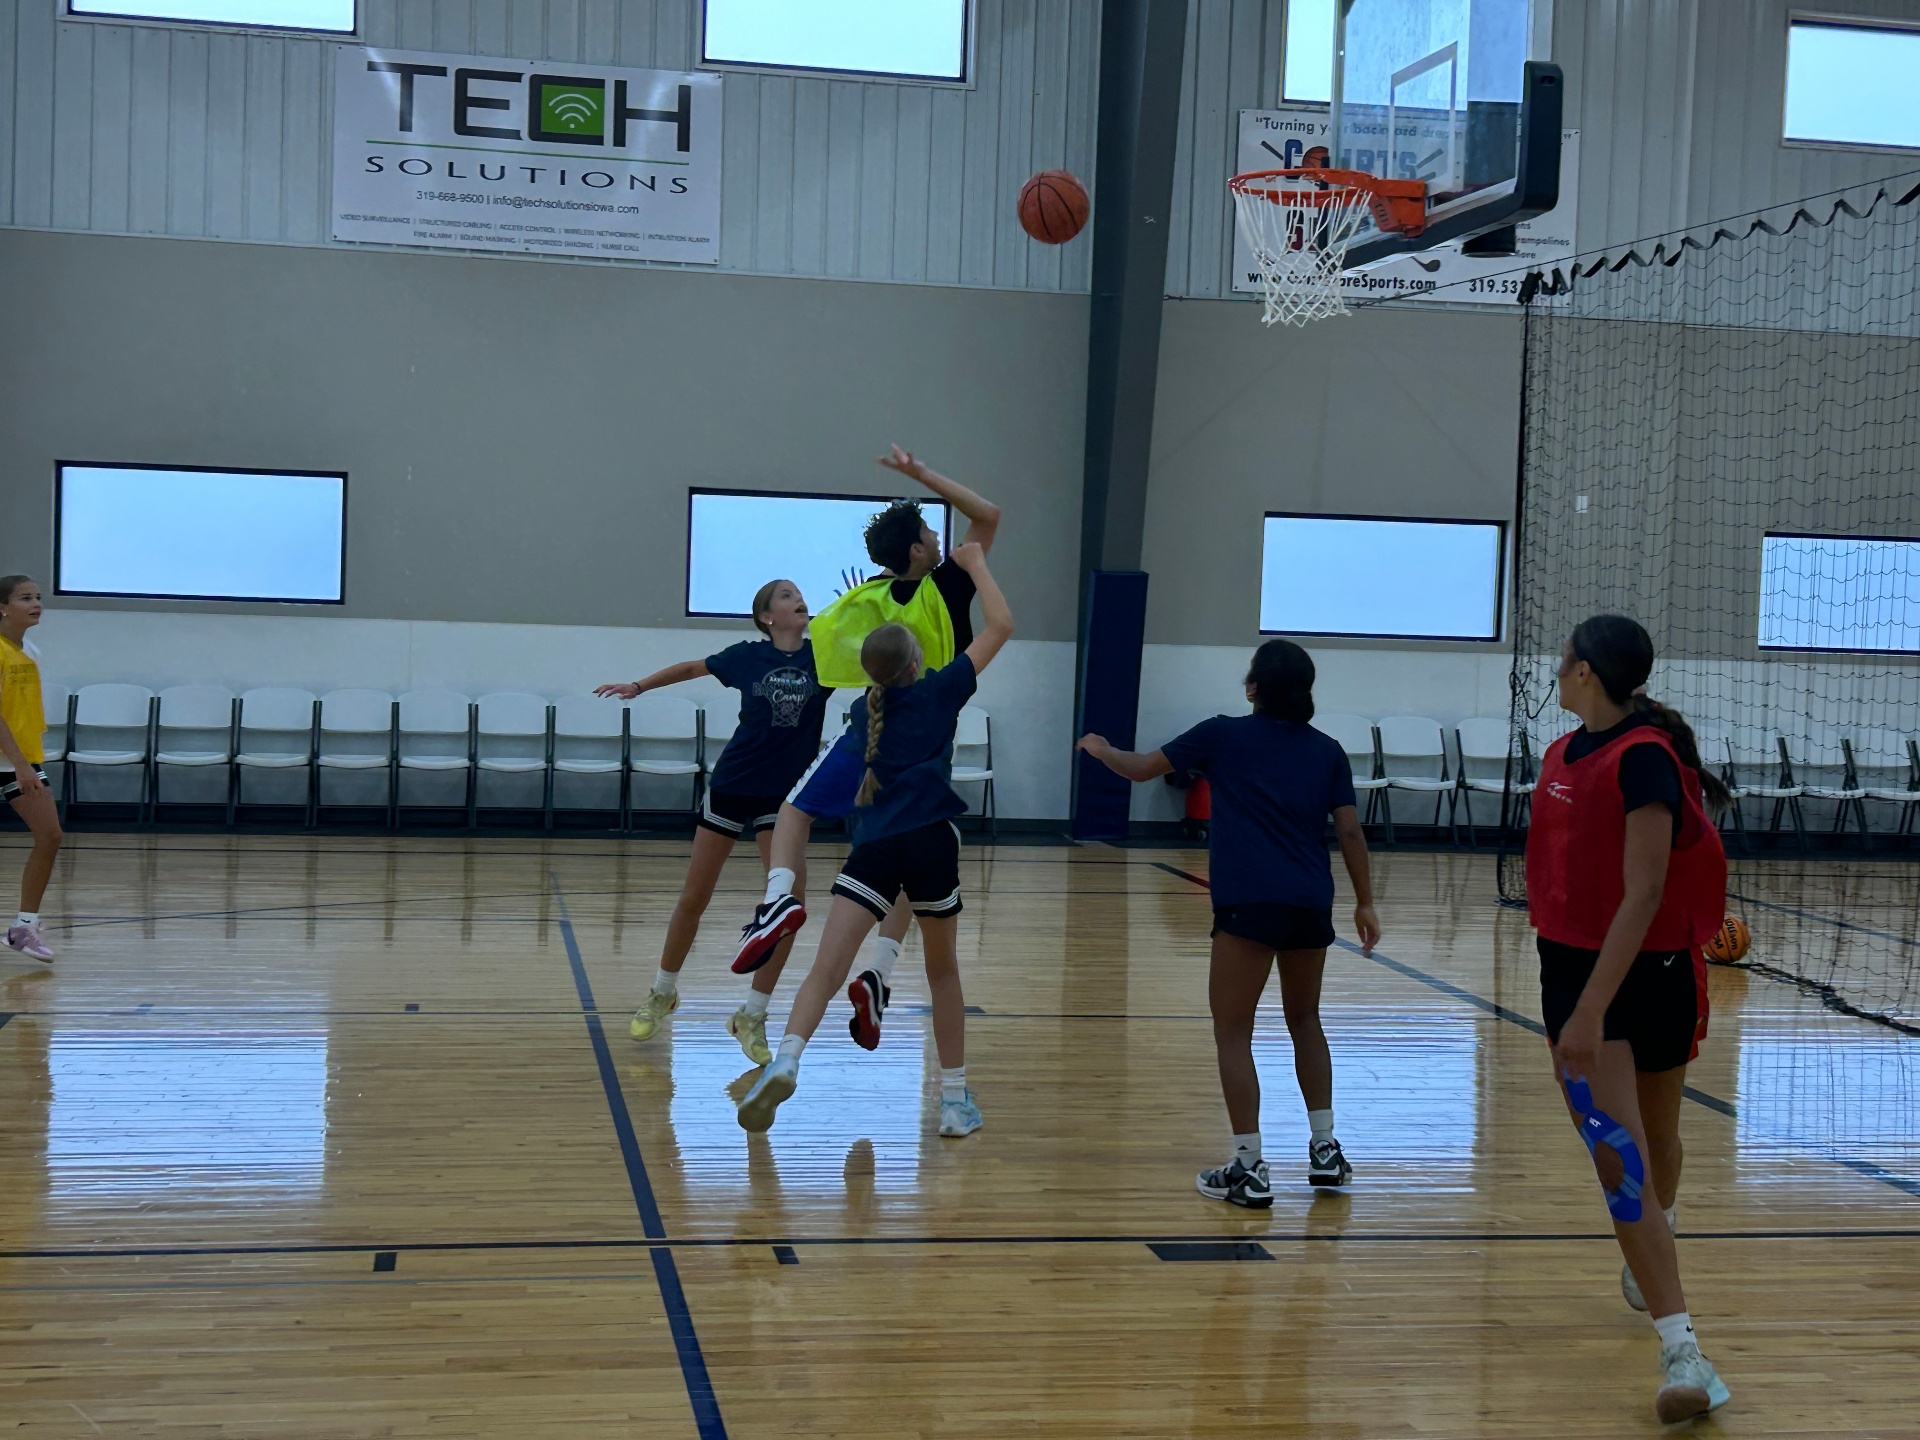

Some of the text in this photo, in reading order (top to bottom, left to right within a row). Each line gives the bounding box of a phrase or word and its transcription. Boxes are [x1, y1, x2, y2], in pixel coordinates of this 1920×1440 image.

[367, 60, 692, 153] TECH
[1255, 116, 1315, 135] "Turning
[1353, 121, 1417, 138] backard
[364, 155, 689, 194] SOLUTIONS
[416, 190, 640, 215] 319-668-9500 info@techsolutionsiowa.com
[525, 225, 556, 234] CONTROL
